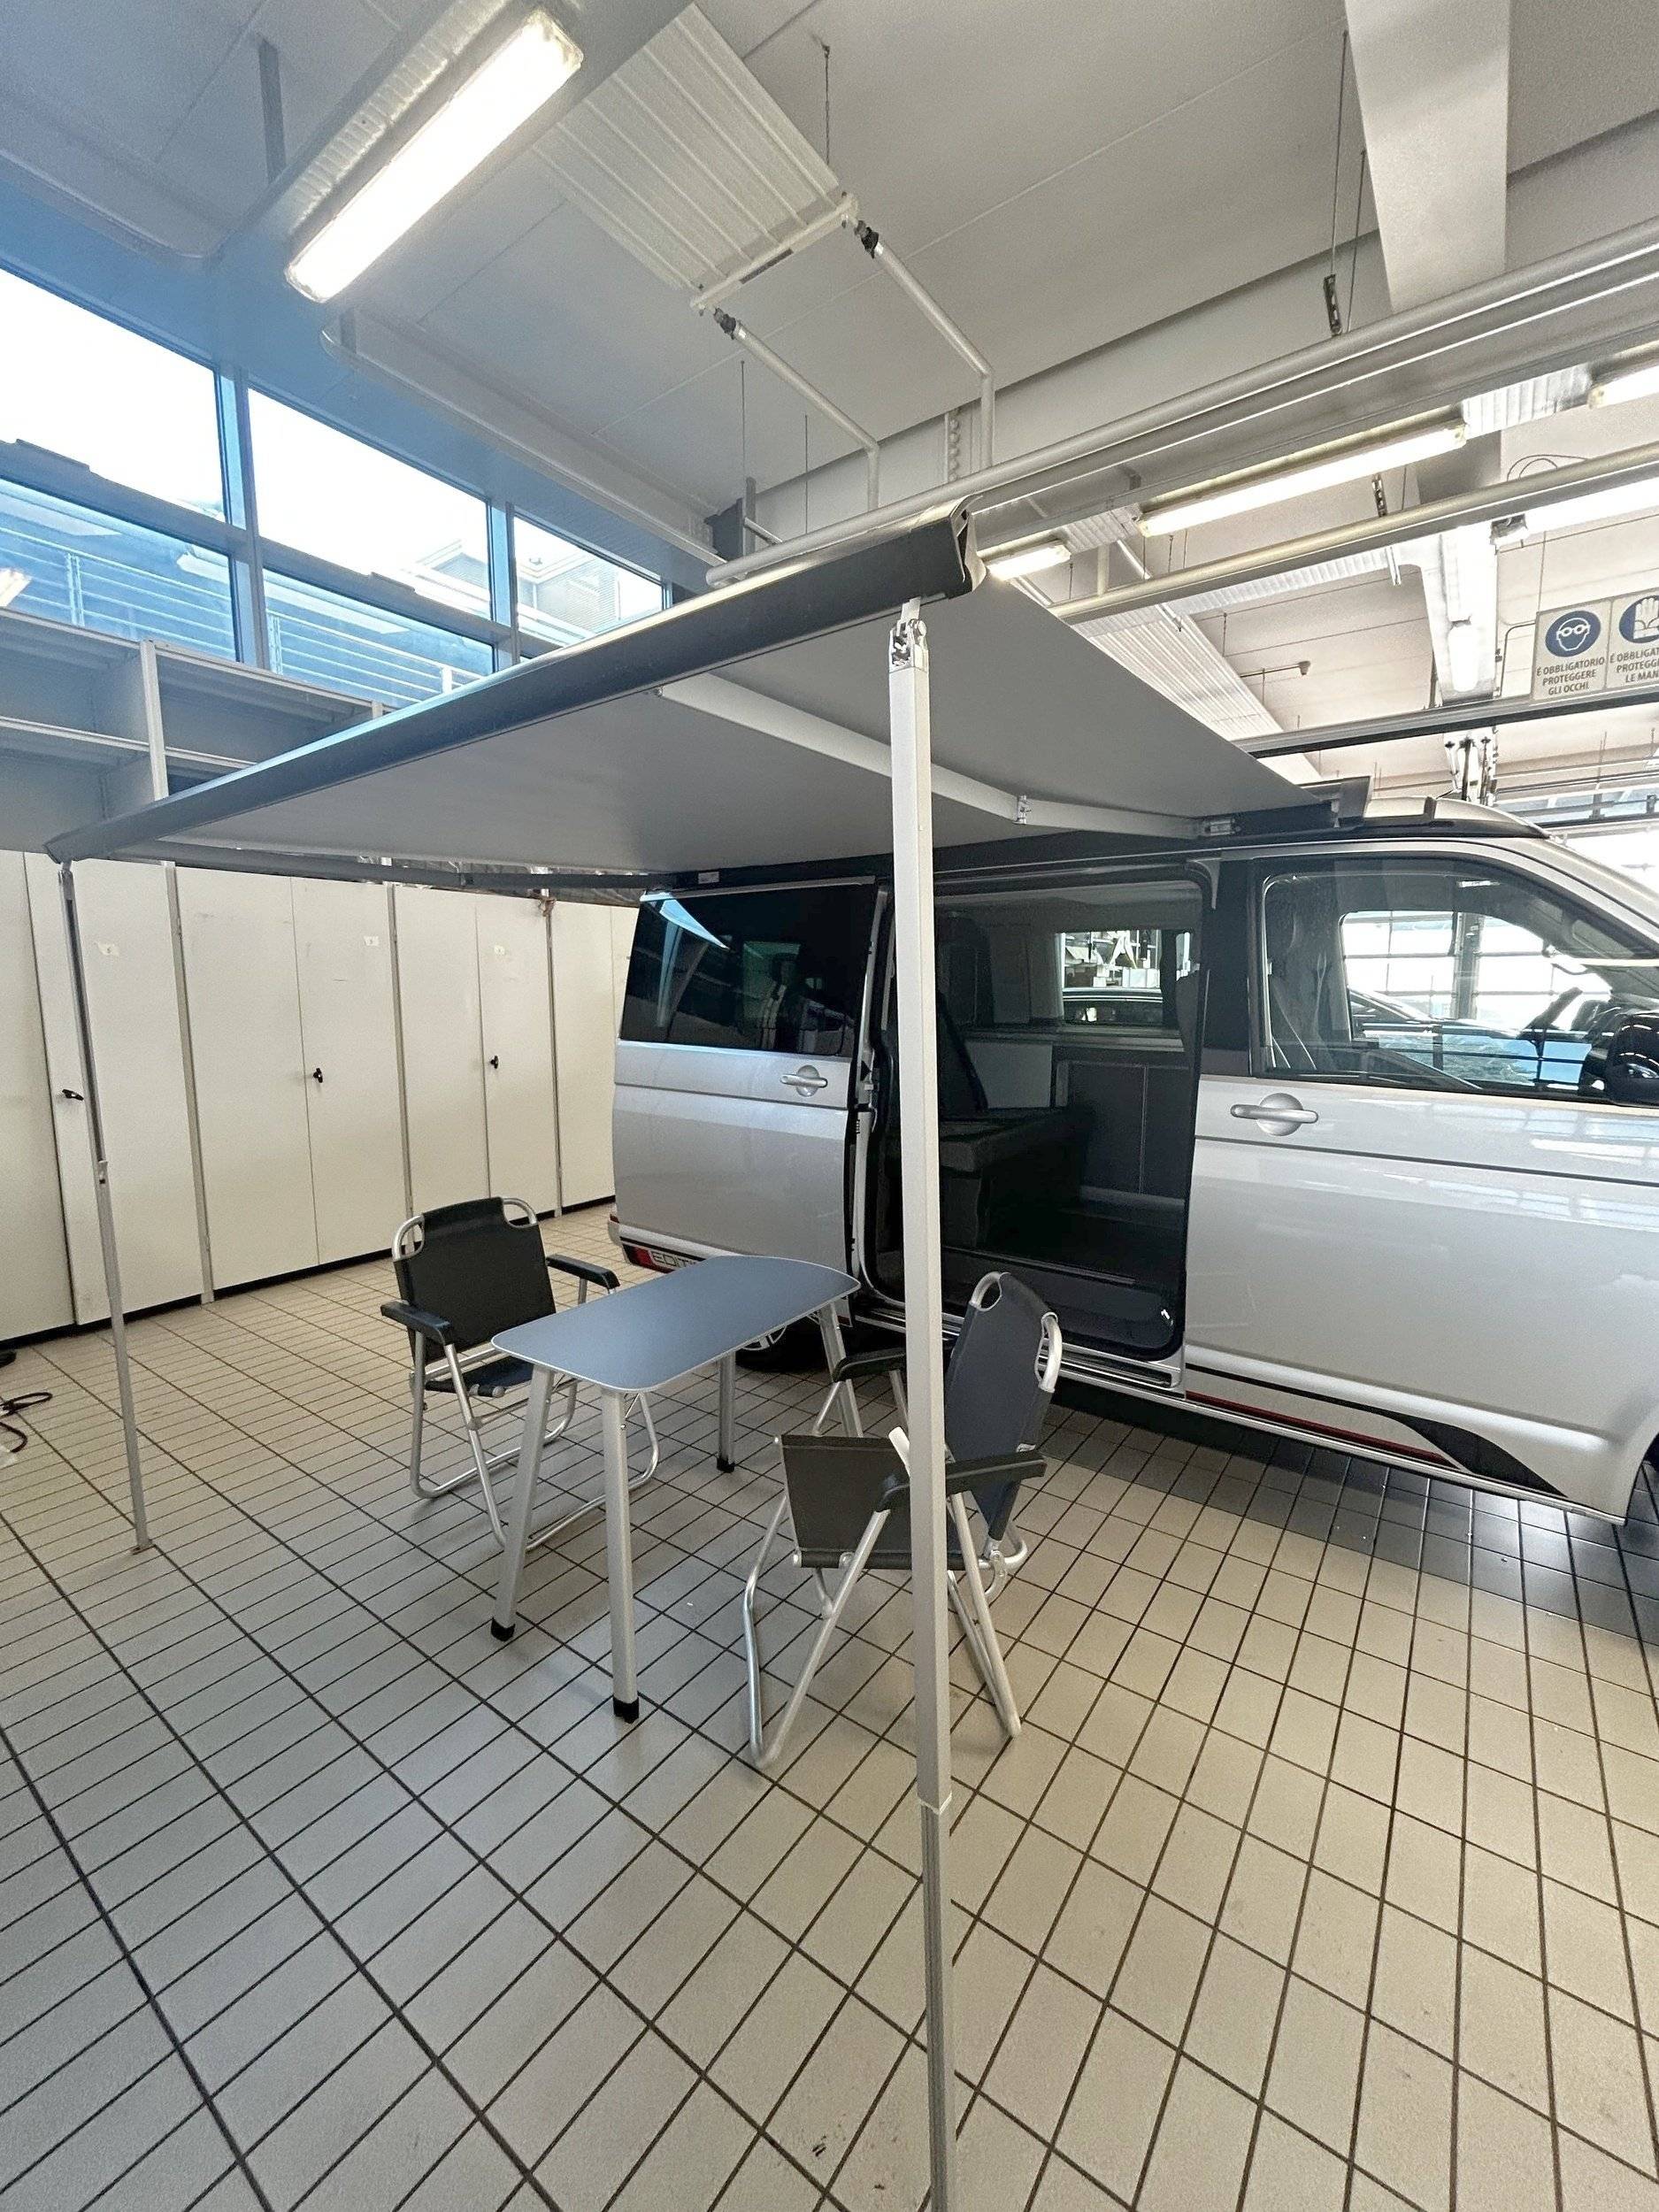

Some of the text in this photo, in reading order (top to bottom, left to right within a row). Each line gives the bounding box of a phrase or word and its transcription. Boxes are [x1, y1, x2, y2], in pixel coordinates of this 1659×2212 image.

[1543, 657, 1605, 675] OBBLIGATORIO
[1542, 669, 1597, 686] PROTEGGERE
[1625, 673, 1635, 682] LE
[1548, 686, 1562, 695] GLI
[651, 1250, 695, 1267] EDIT
